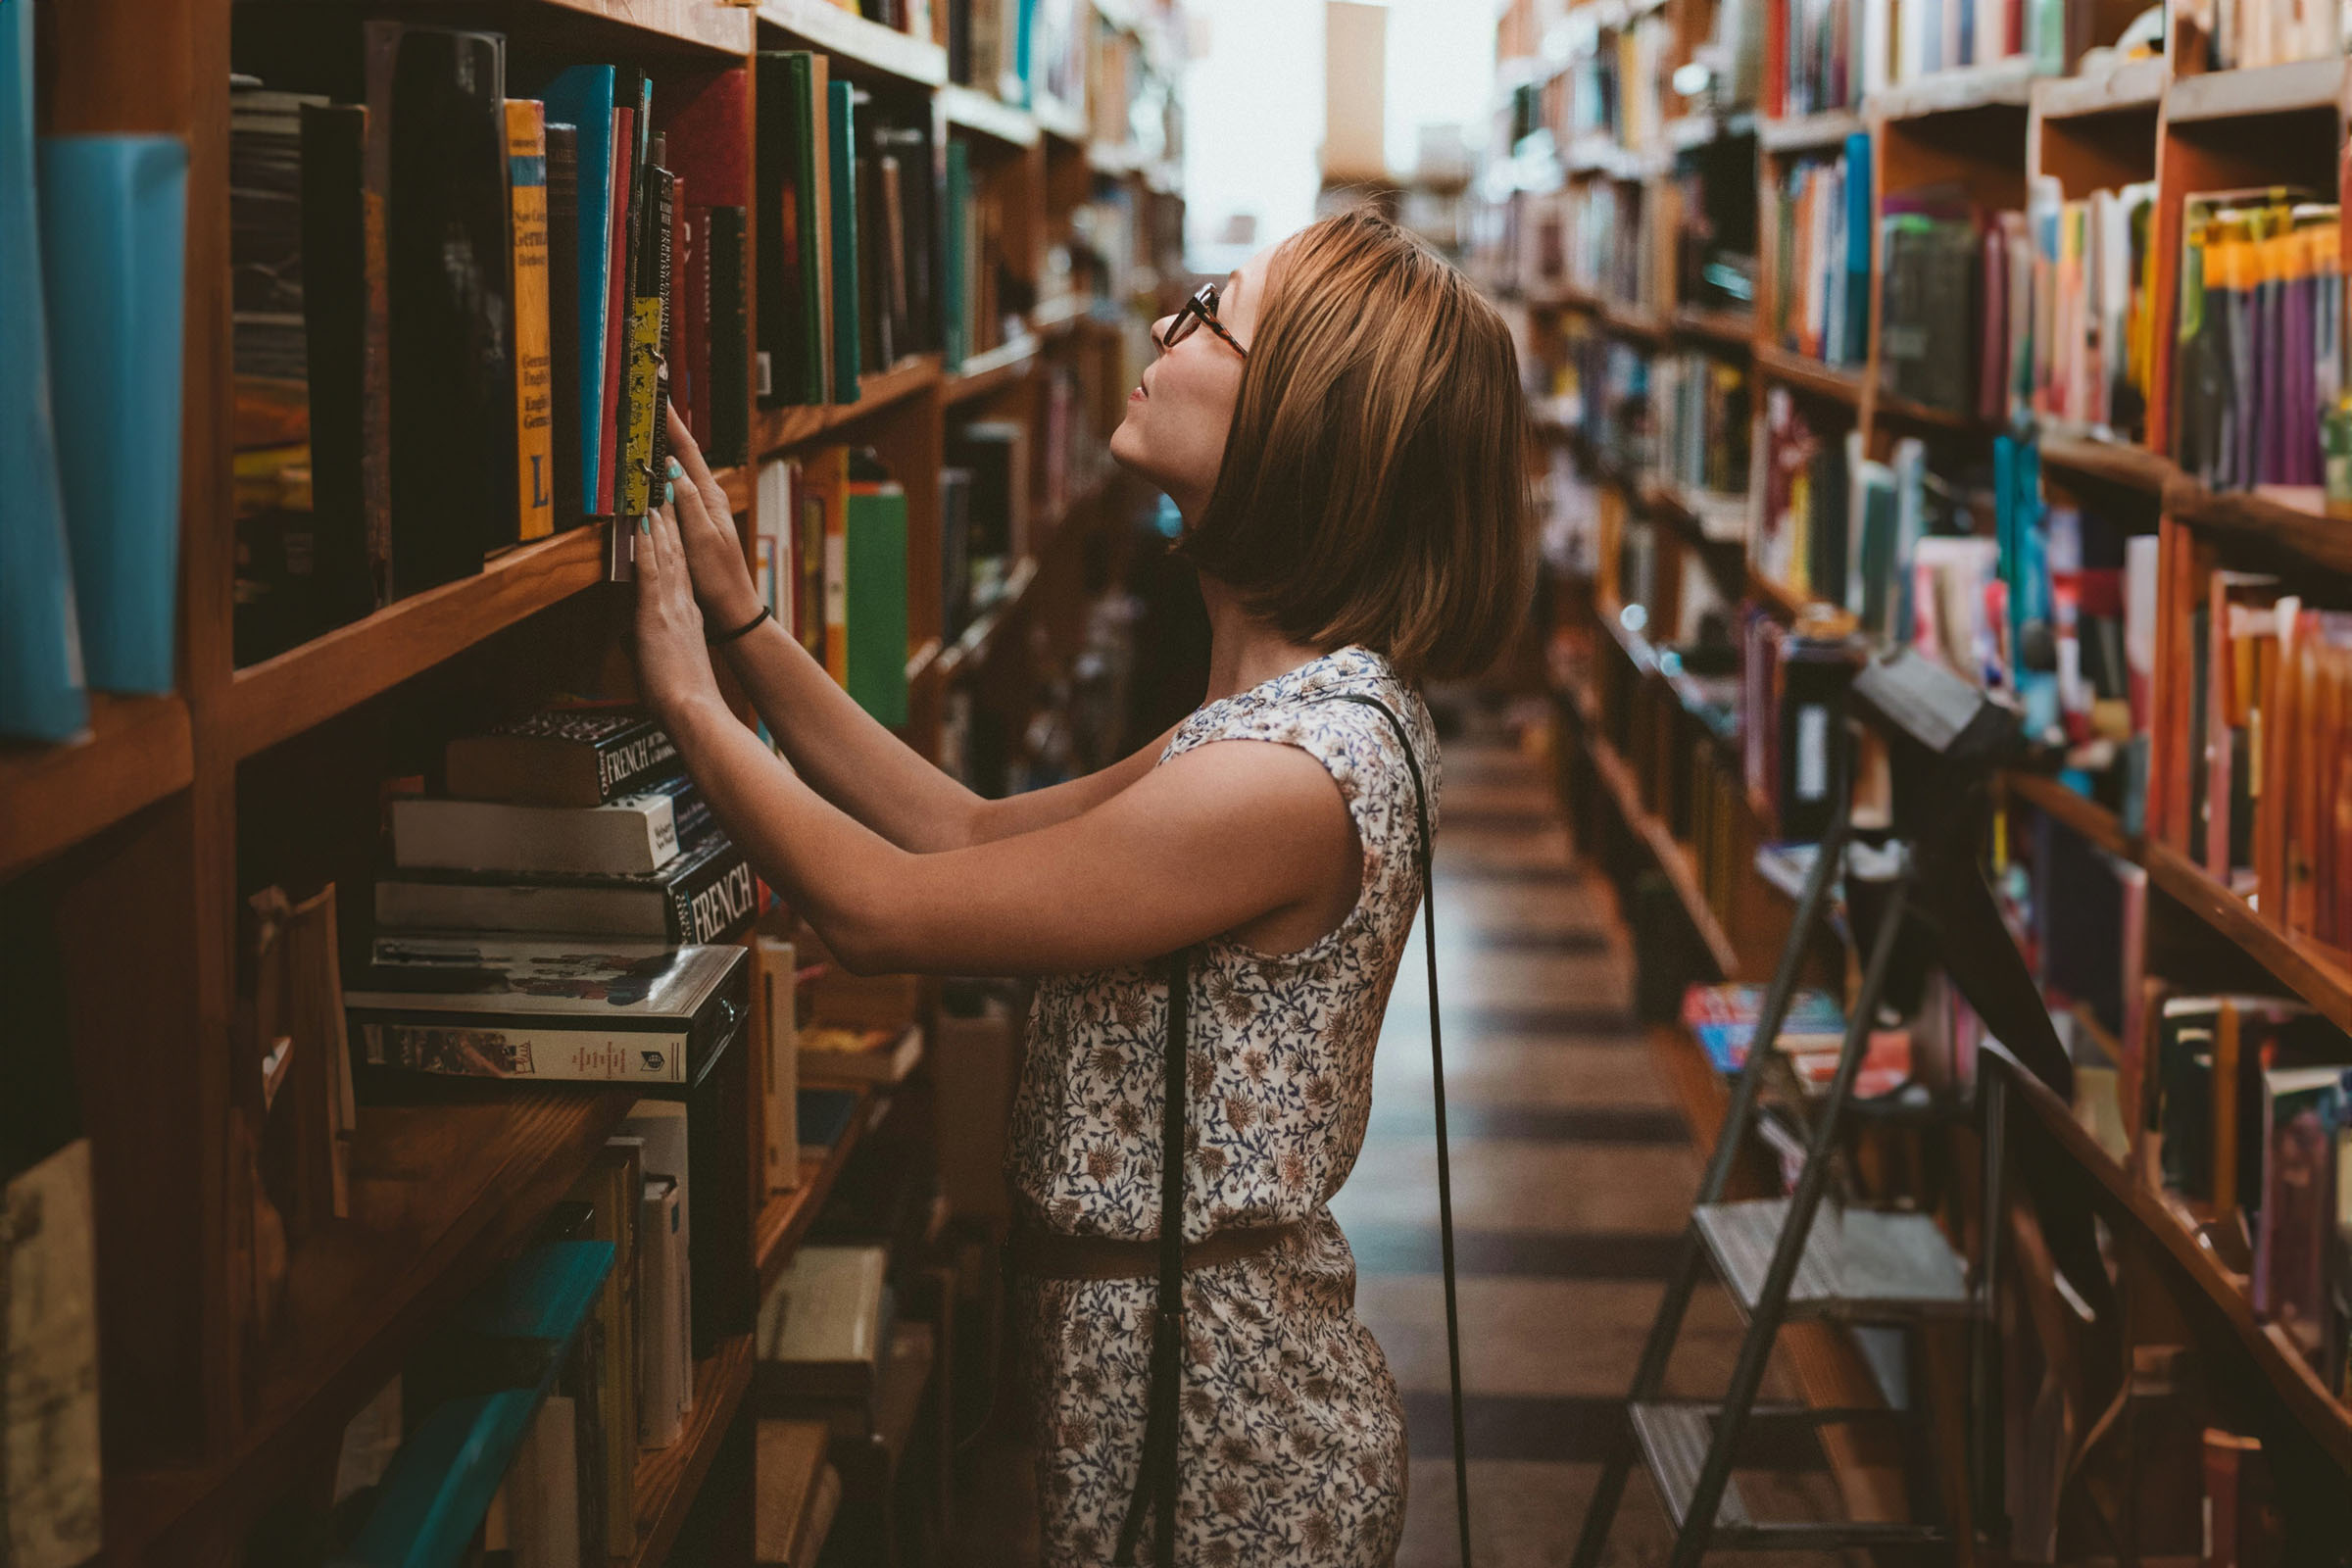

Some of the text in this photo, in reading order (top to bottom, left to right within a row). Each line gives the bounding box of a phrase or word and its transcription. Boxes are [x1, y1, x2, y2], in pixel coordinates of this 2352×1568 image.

[530, 455, 549, 509] L
[606, 737, 650, 785] FRENCH
[691, 861, 754, 946] FRENCH
